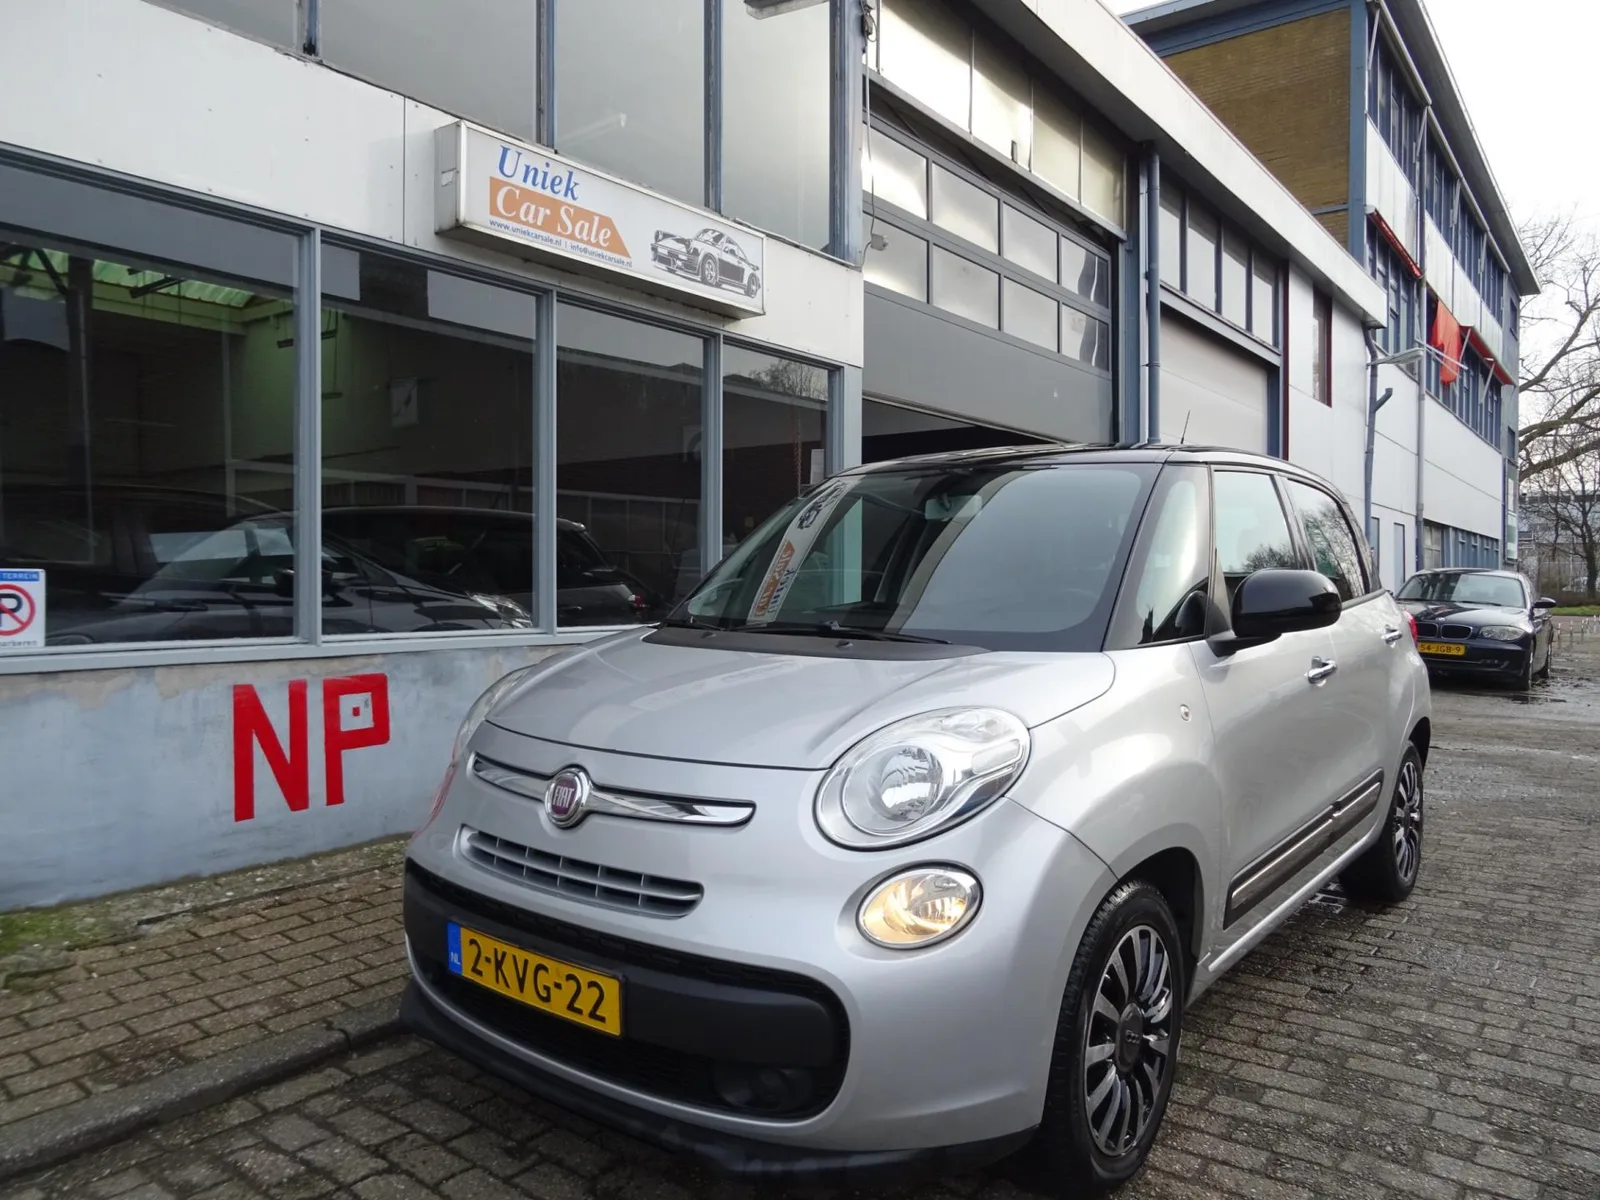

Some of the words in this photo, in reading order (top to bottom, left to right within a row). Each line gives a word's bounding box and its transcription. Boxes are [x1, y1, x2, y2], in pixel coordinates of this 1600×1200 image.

[498, 145, 580, 201] Uniek
[489, 219, 562, 247] www.uniekcarsale.nl
[570, 243, 633, 268] info@uniekcarsale.nl
[496, 186, 551, 226] Car
[557, 206, 612, 248] Sale
[233, 673, 391, 823] NP
[552, 785, 575, 808] FIAT
[450, 951, 461, 966] NL
[469, 938, 606, 1024] 2-KVG-22
